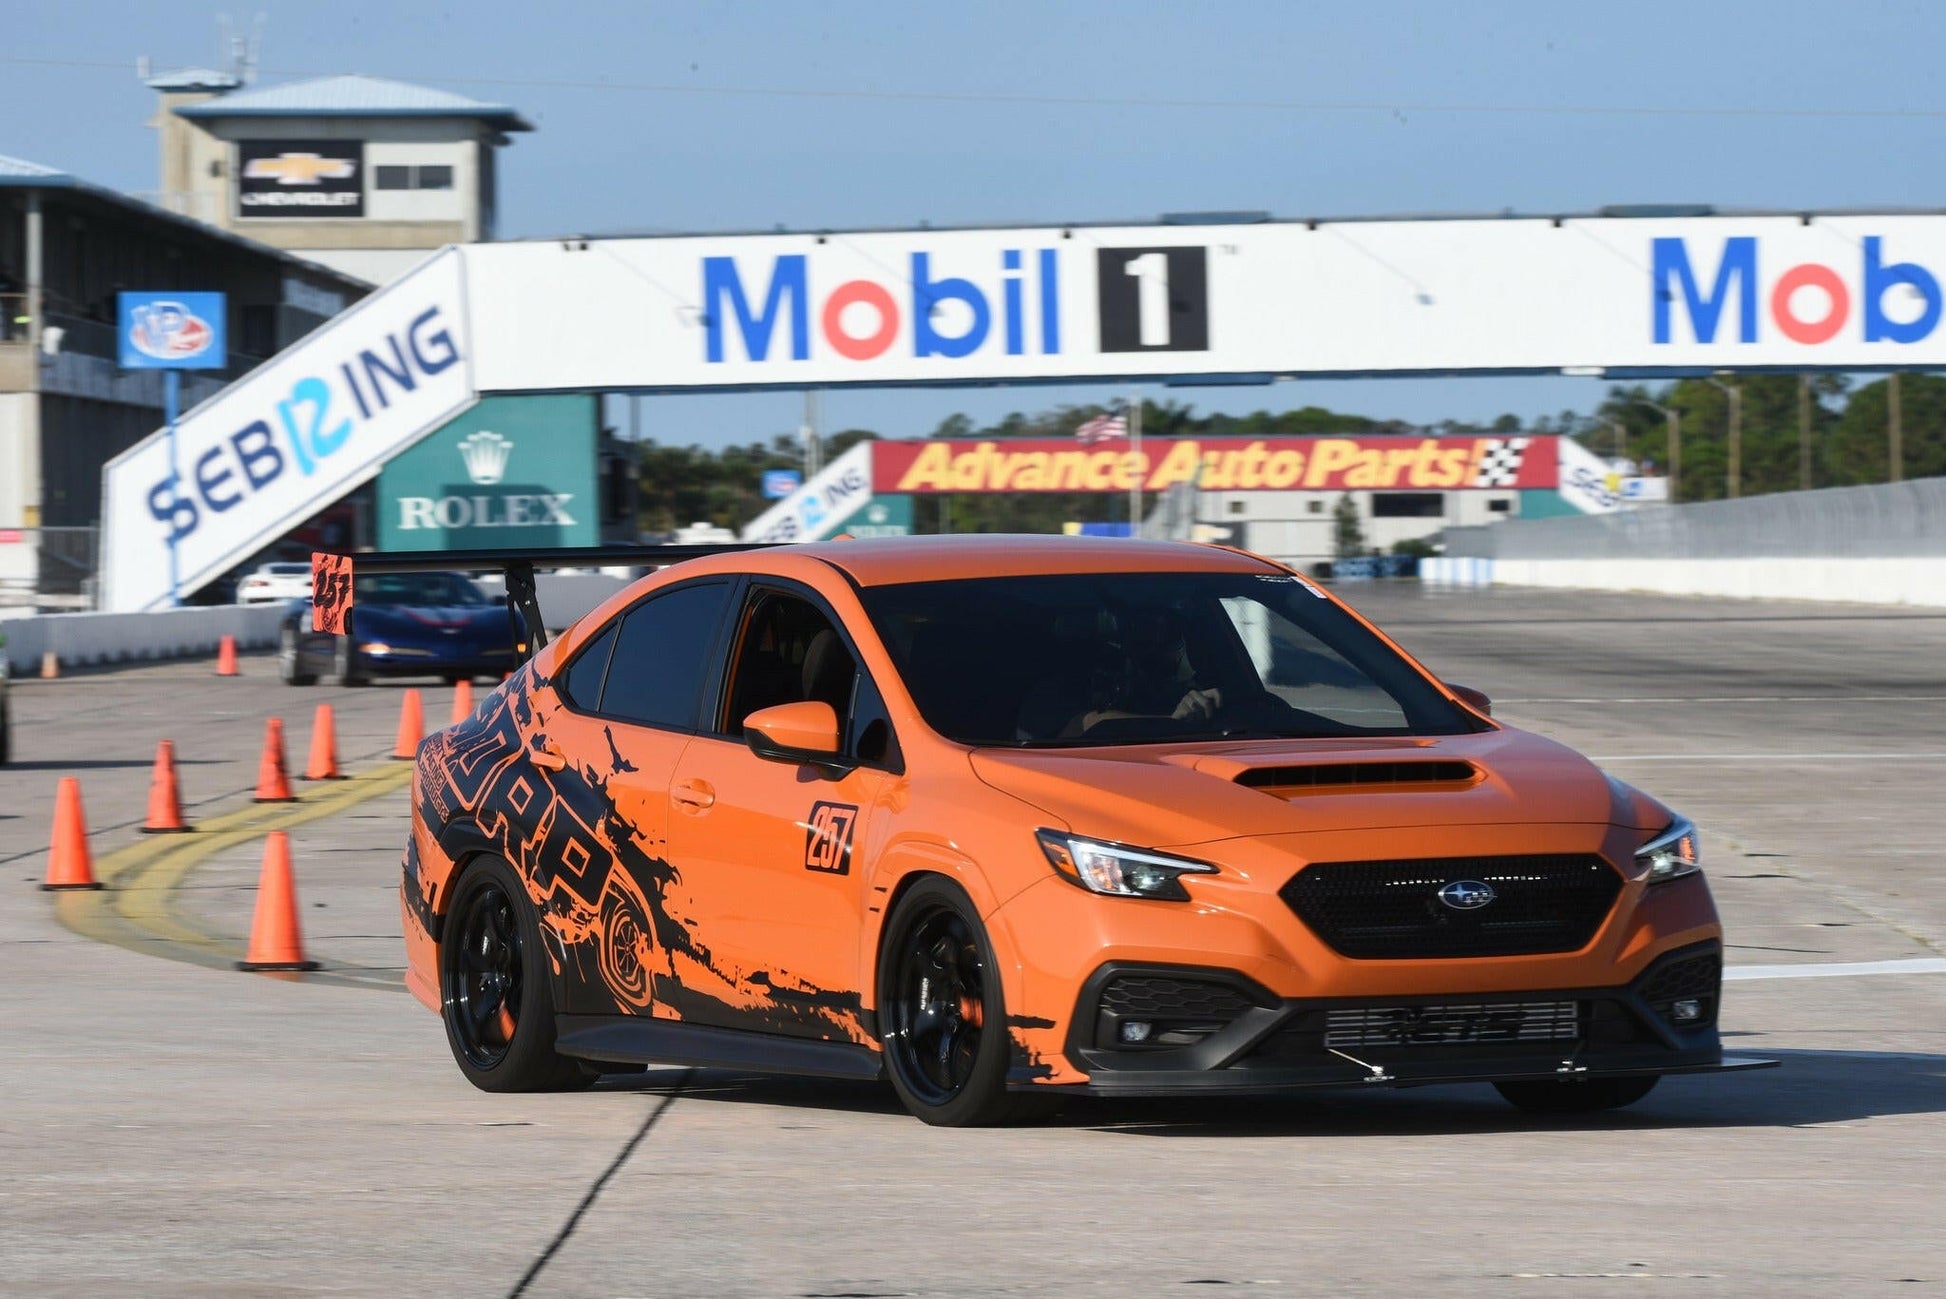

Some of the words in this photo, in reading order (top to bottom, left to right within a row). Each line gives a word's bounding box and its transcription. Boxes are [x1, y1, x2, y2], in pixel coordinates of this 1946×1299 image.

[701, 247, 1060, 363] Mobil
[896, 441, 1150, 490] Advance
[1146, 439, 1303, 490] Auto
[397, 493, 578, 530] ROLEX
[806, 805, 857, 870] 257
